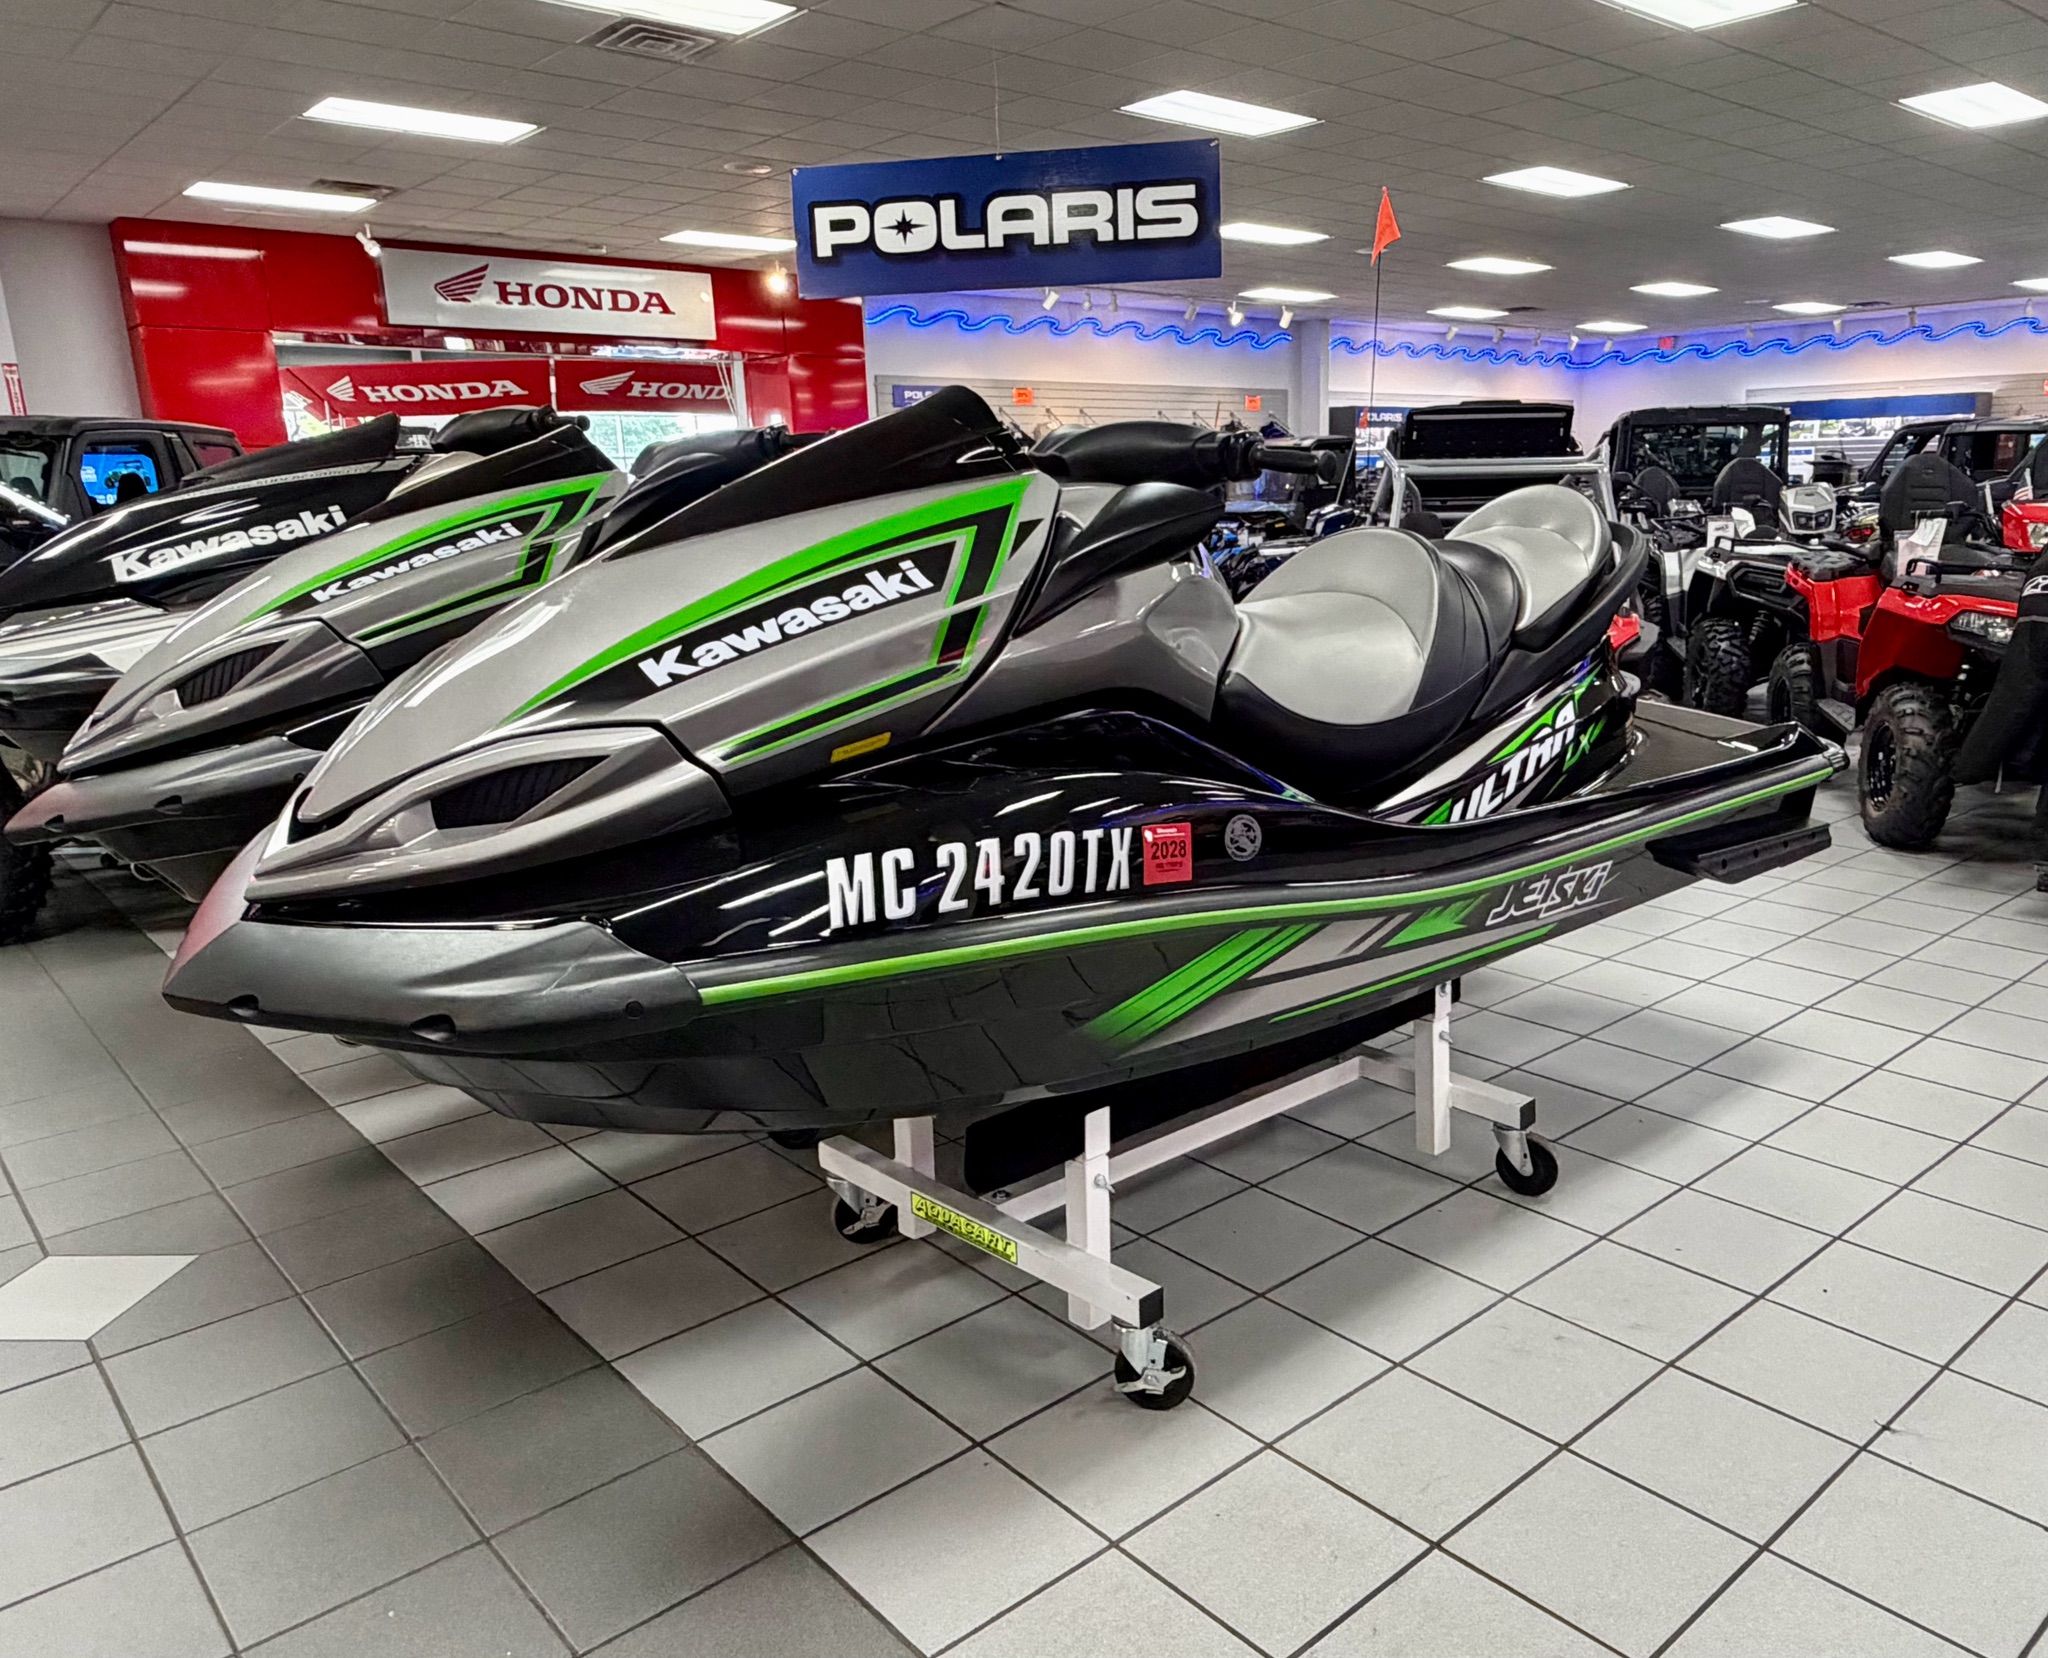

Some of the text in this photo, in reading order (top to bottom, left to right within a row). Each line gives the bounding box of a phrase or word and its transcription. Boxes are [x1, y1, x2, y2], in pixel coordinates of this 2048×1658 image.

[813, 184, 1199, 258] POLARIS
[493, 280, 676, 315] HONDA
[357, 380, 529, 403] HONDA
[626, 381, 730, 400] HOND
[111, 505, 349, 584] Kawasaki
[311, 522, 524, 603] Kawasaki
[638, 559, 935, 687] Kawasaki
[1450, 699, 1577, 823] ULTRA
[826, 847, 917, 930] MC
[936, 826, 1134, 914] 2420TX
[1150, 839, 1188, 861] 2028
